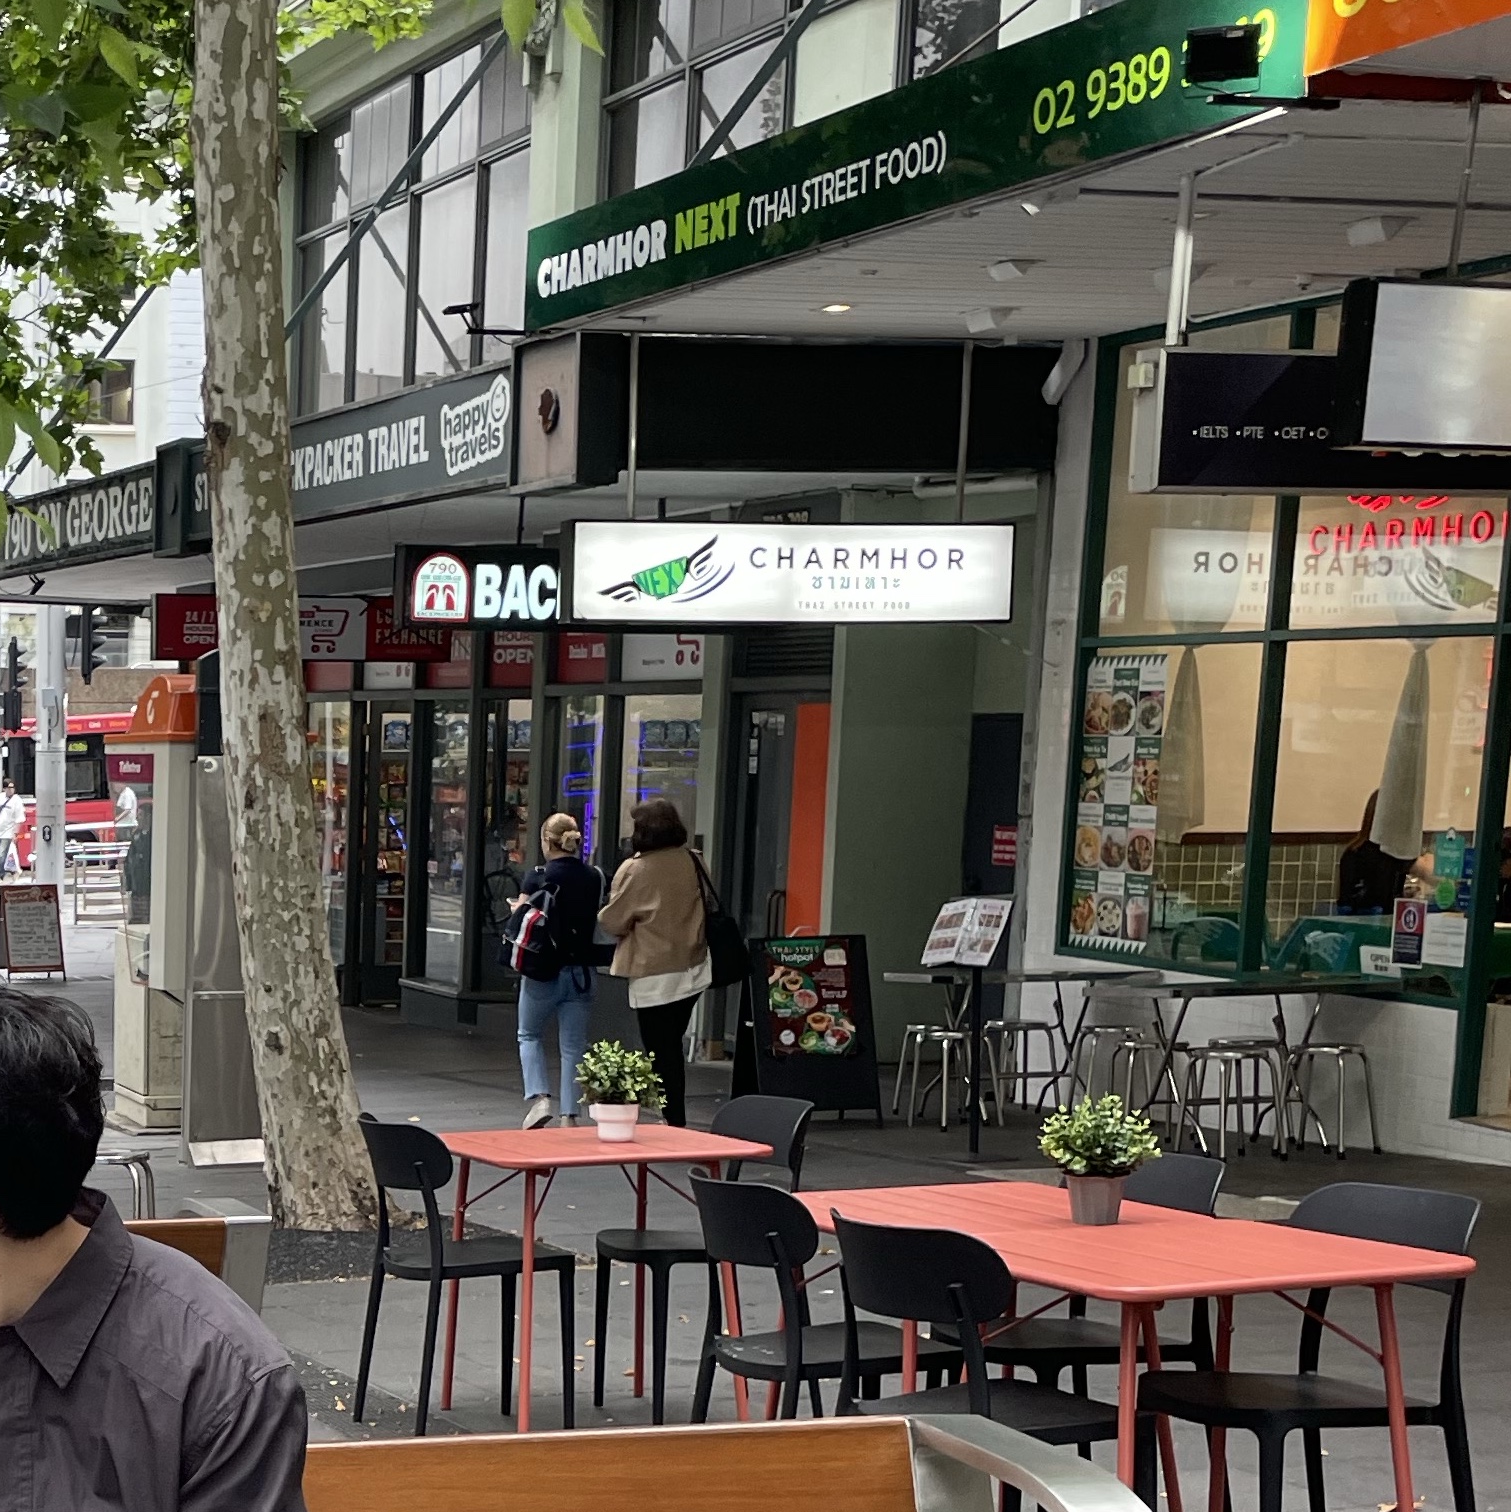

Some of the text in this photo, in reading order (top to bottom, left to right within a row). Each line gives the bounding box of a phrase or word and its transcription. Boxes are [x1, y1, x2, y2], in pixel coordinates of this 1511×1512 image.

[1034, 78, 1075, 134] 02
[1086, 46, 1170, 119] 9389
[537, 130, 948, 298] CHARMHOR NEXT (THAI STREET FOOD)
[443, 401, 489, 441] happy
[1199, 426, 1229, 439] IELTS
[1243, 426, 1264, 439] PTE
[290, 415, 430, 491] KPACKER TRAVEL
[448, 423, 501, 469] travels
[66, 478, 154, 547] GEORGE
[1308, 510, 1509, 556] CHARMHO
[429, 563, 458, 574] 790
[633, 557, 688, 598] NEXT
[749, 547, 966, 570] CHARMHOR
[474, 563, 562, 620] BAC
[183, 635, 216, 645] OPEN
[375, 629, 444, 645] EXCHANGE
[497, 631, 533, 641] HOUR
